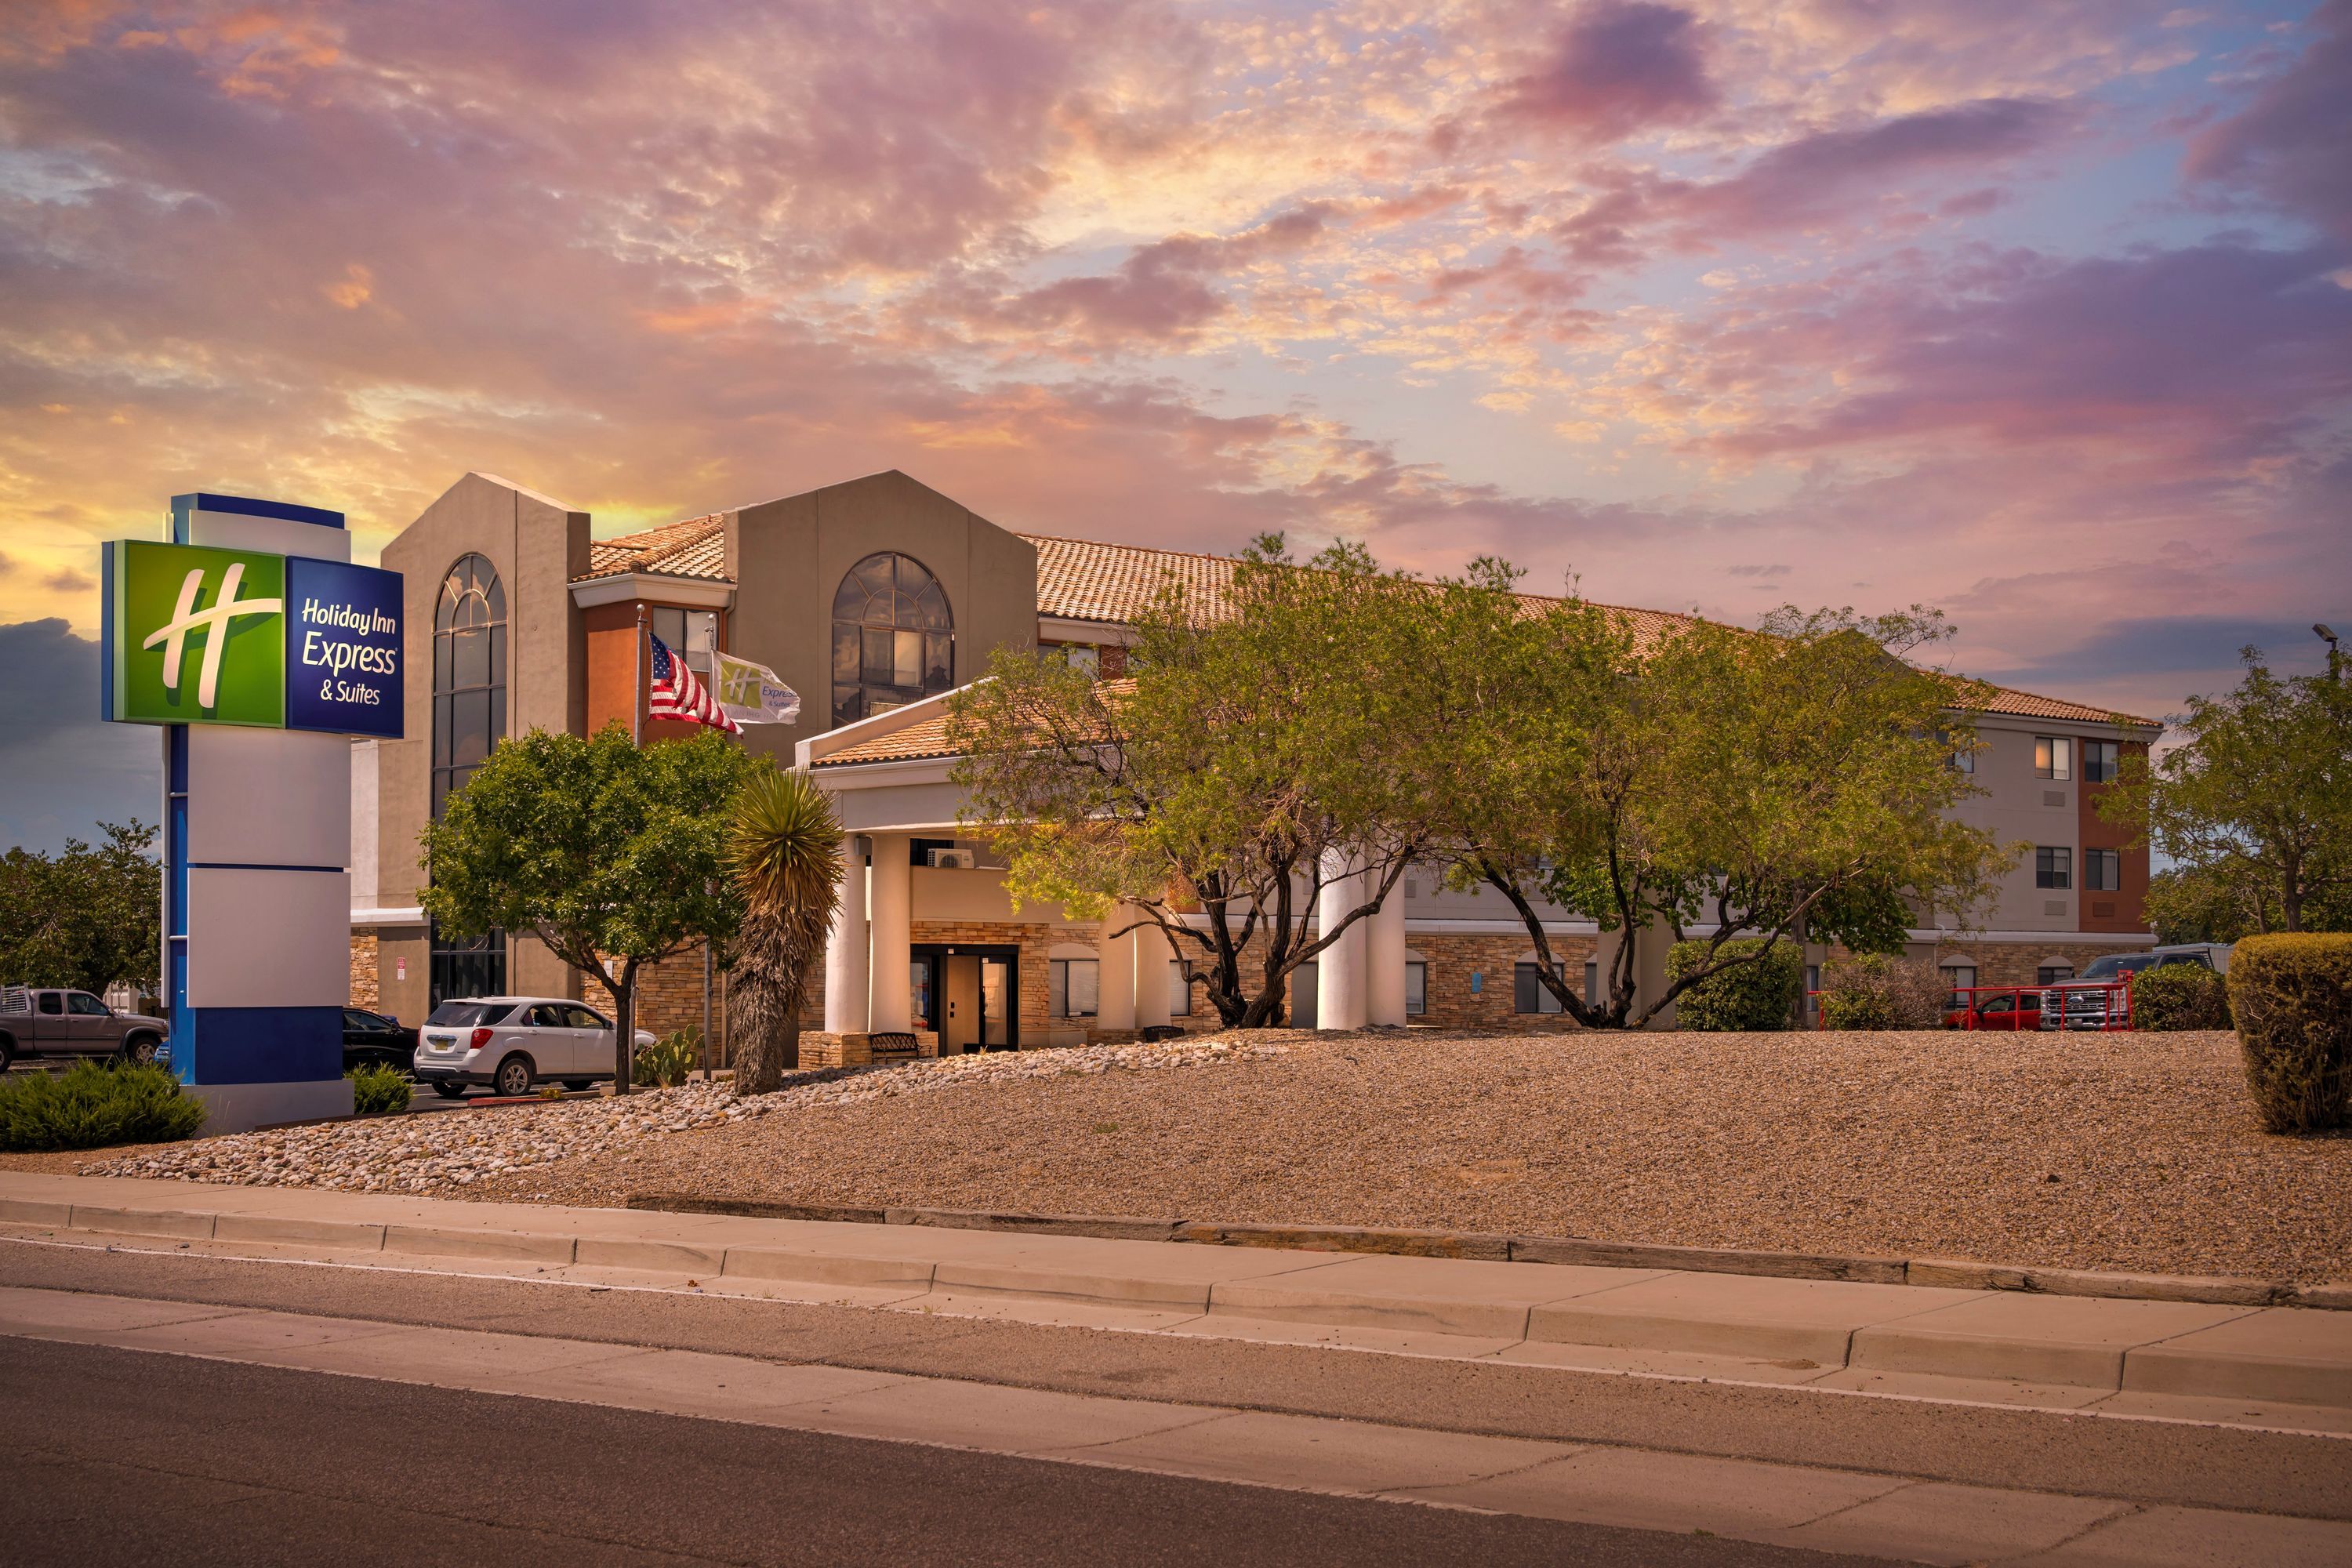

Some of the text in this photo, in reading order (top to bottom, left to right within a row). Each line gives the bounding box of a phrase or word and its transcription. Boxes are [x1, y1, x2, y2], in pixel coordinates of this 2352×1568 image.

[301, 597, 396, 636] Holiday Inn
[302, 630, 396, 677] Express
[320, 678, 381, 706] & Suites
